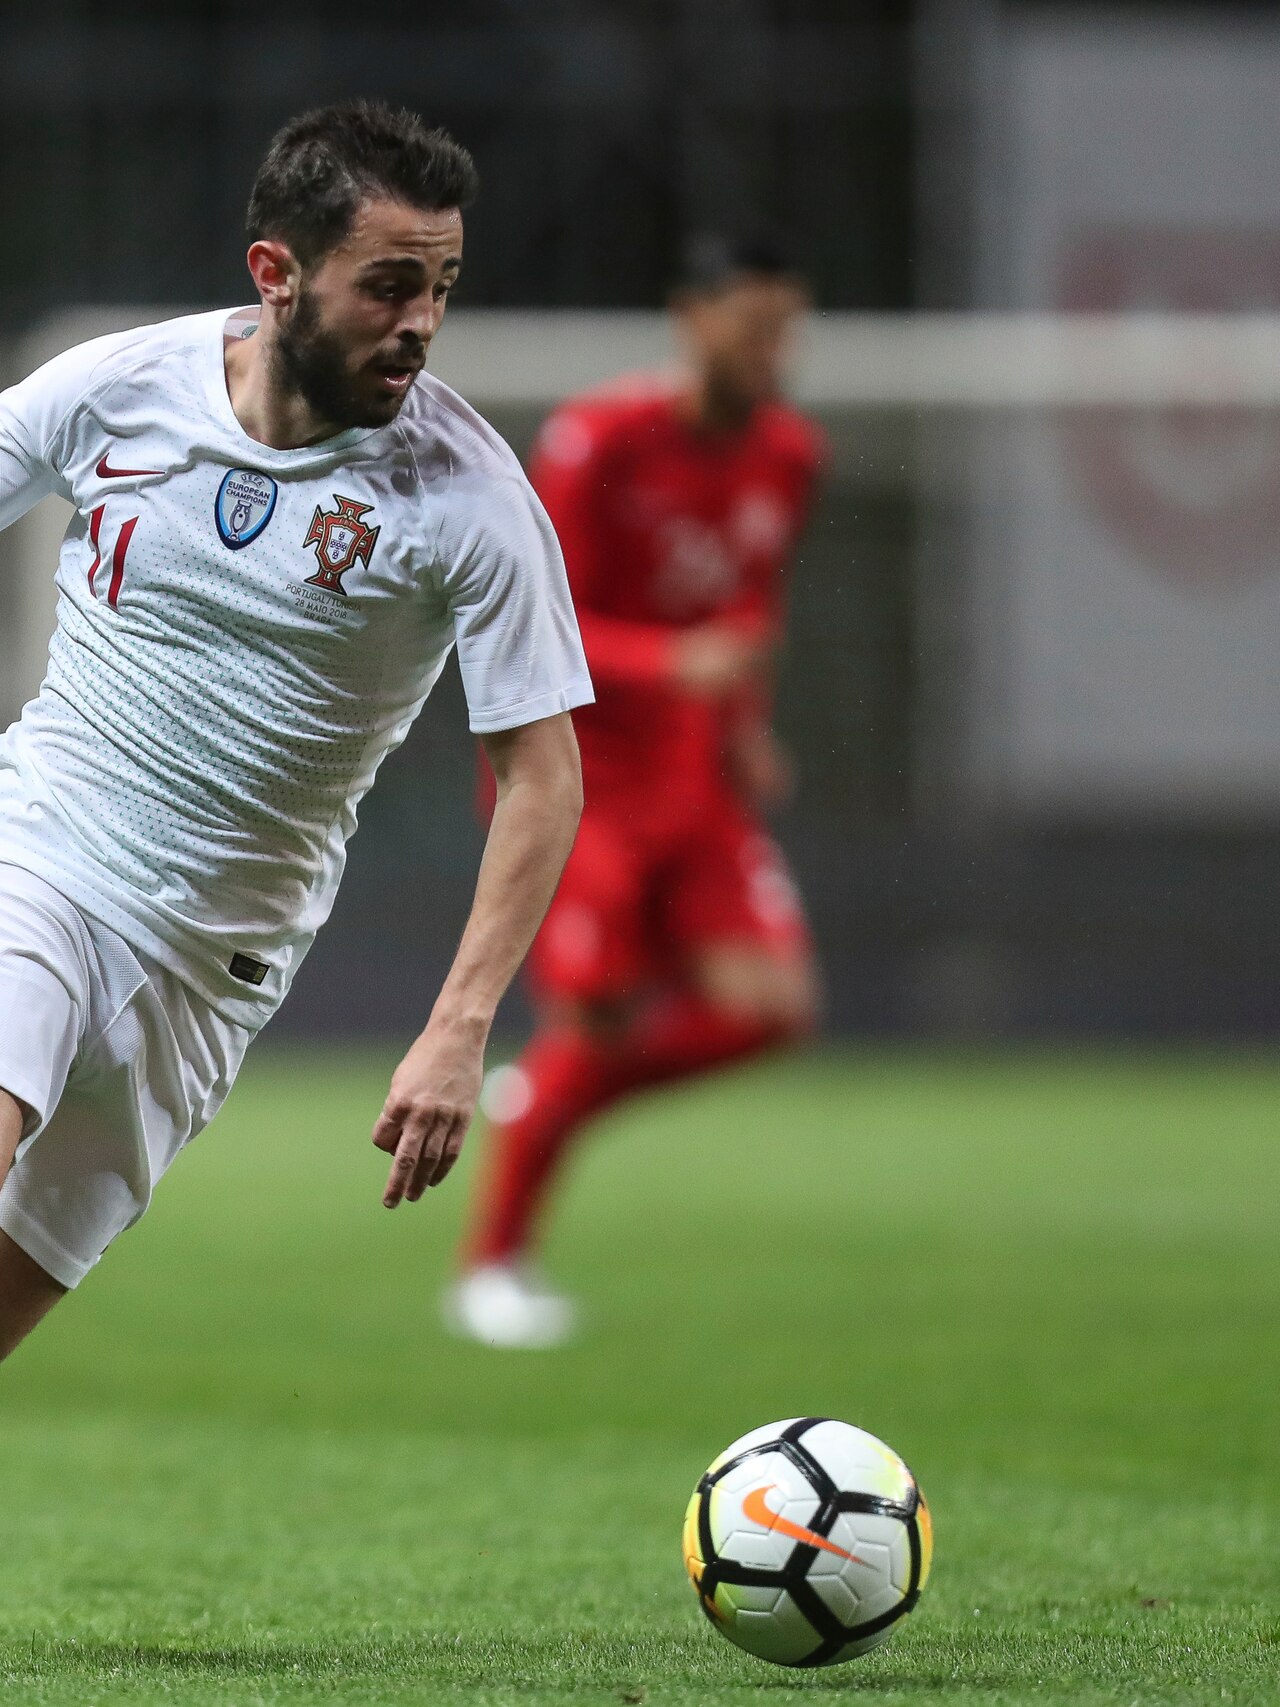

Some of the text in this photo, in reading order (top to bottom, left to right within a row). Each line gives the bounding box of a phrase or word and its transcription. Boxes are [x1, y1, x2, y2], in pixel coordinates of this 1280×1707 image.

[241, 474, 263, 486] UEFA
[226, 488, 268, 506] CHAMPIONS
[228, 480, 270, 499] EUROPEAN
[87, 503, 140, 612] 11
[295, 597, 348, 619] 28 MAIO 2018
[303, 611, 332, 626] BRAGA
